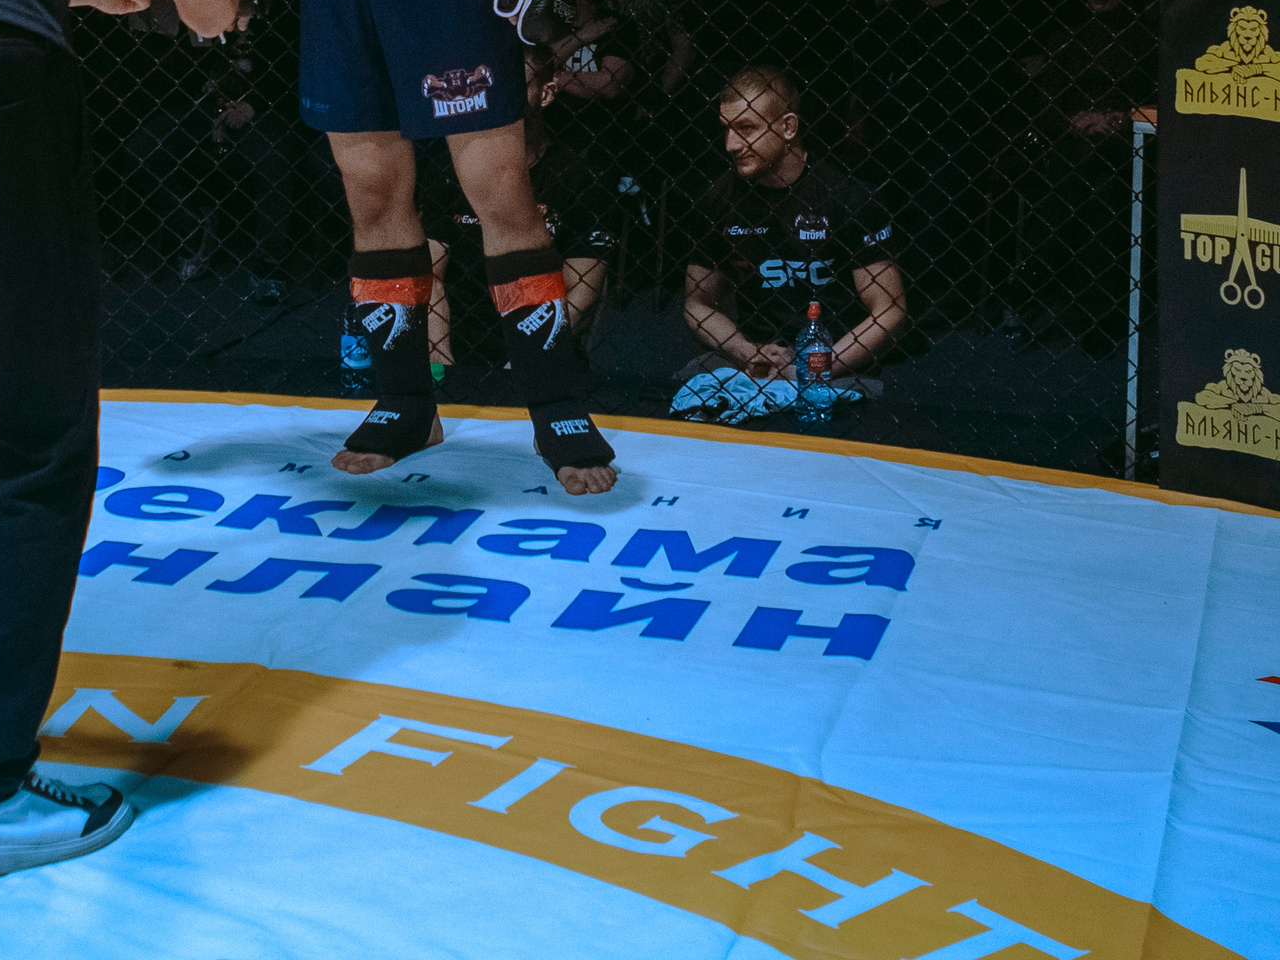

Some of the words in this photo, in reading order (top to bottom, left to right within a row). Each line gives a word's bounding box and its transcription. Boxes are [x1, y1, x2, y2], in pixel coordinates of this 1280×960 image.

[434, 90, 487, 118] ШТОРМ
[1180, 232, 1231, 265] TOP
[759, 257, 836, 289] SFC
[163, 449, 943, 530] ОМПАНИЯ
[77, 540, 892, 661] нлайн
